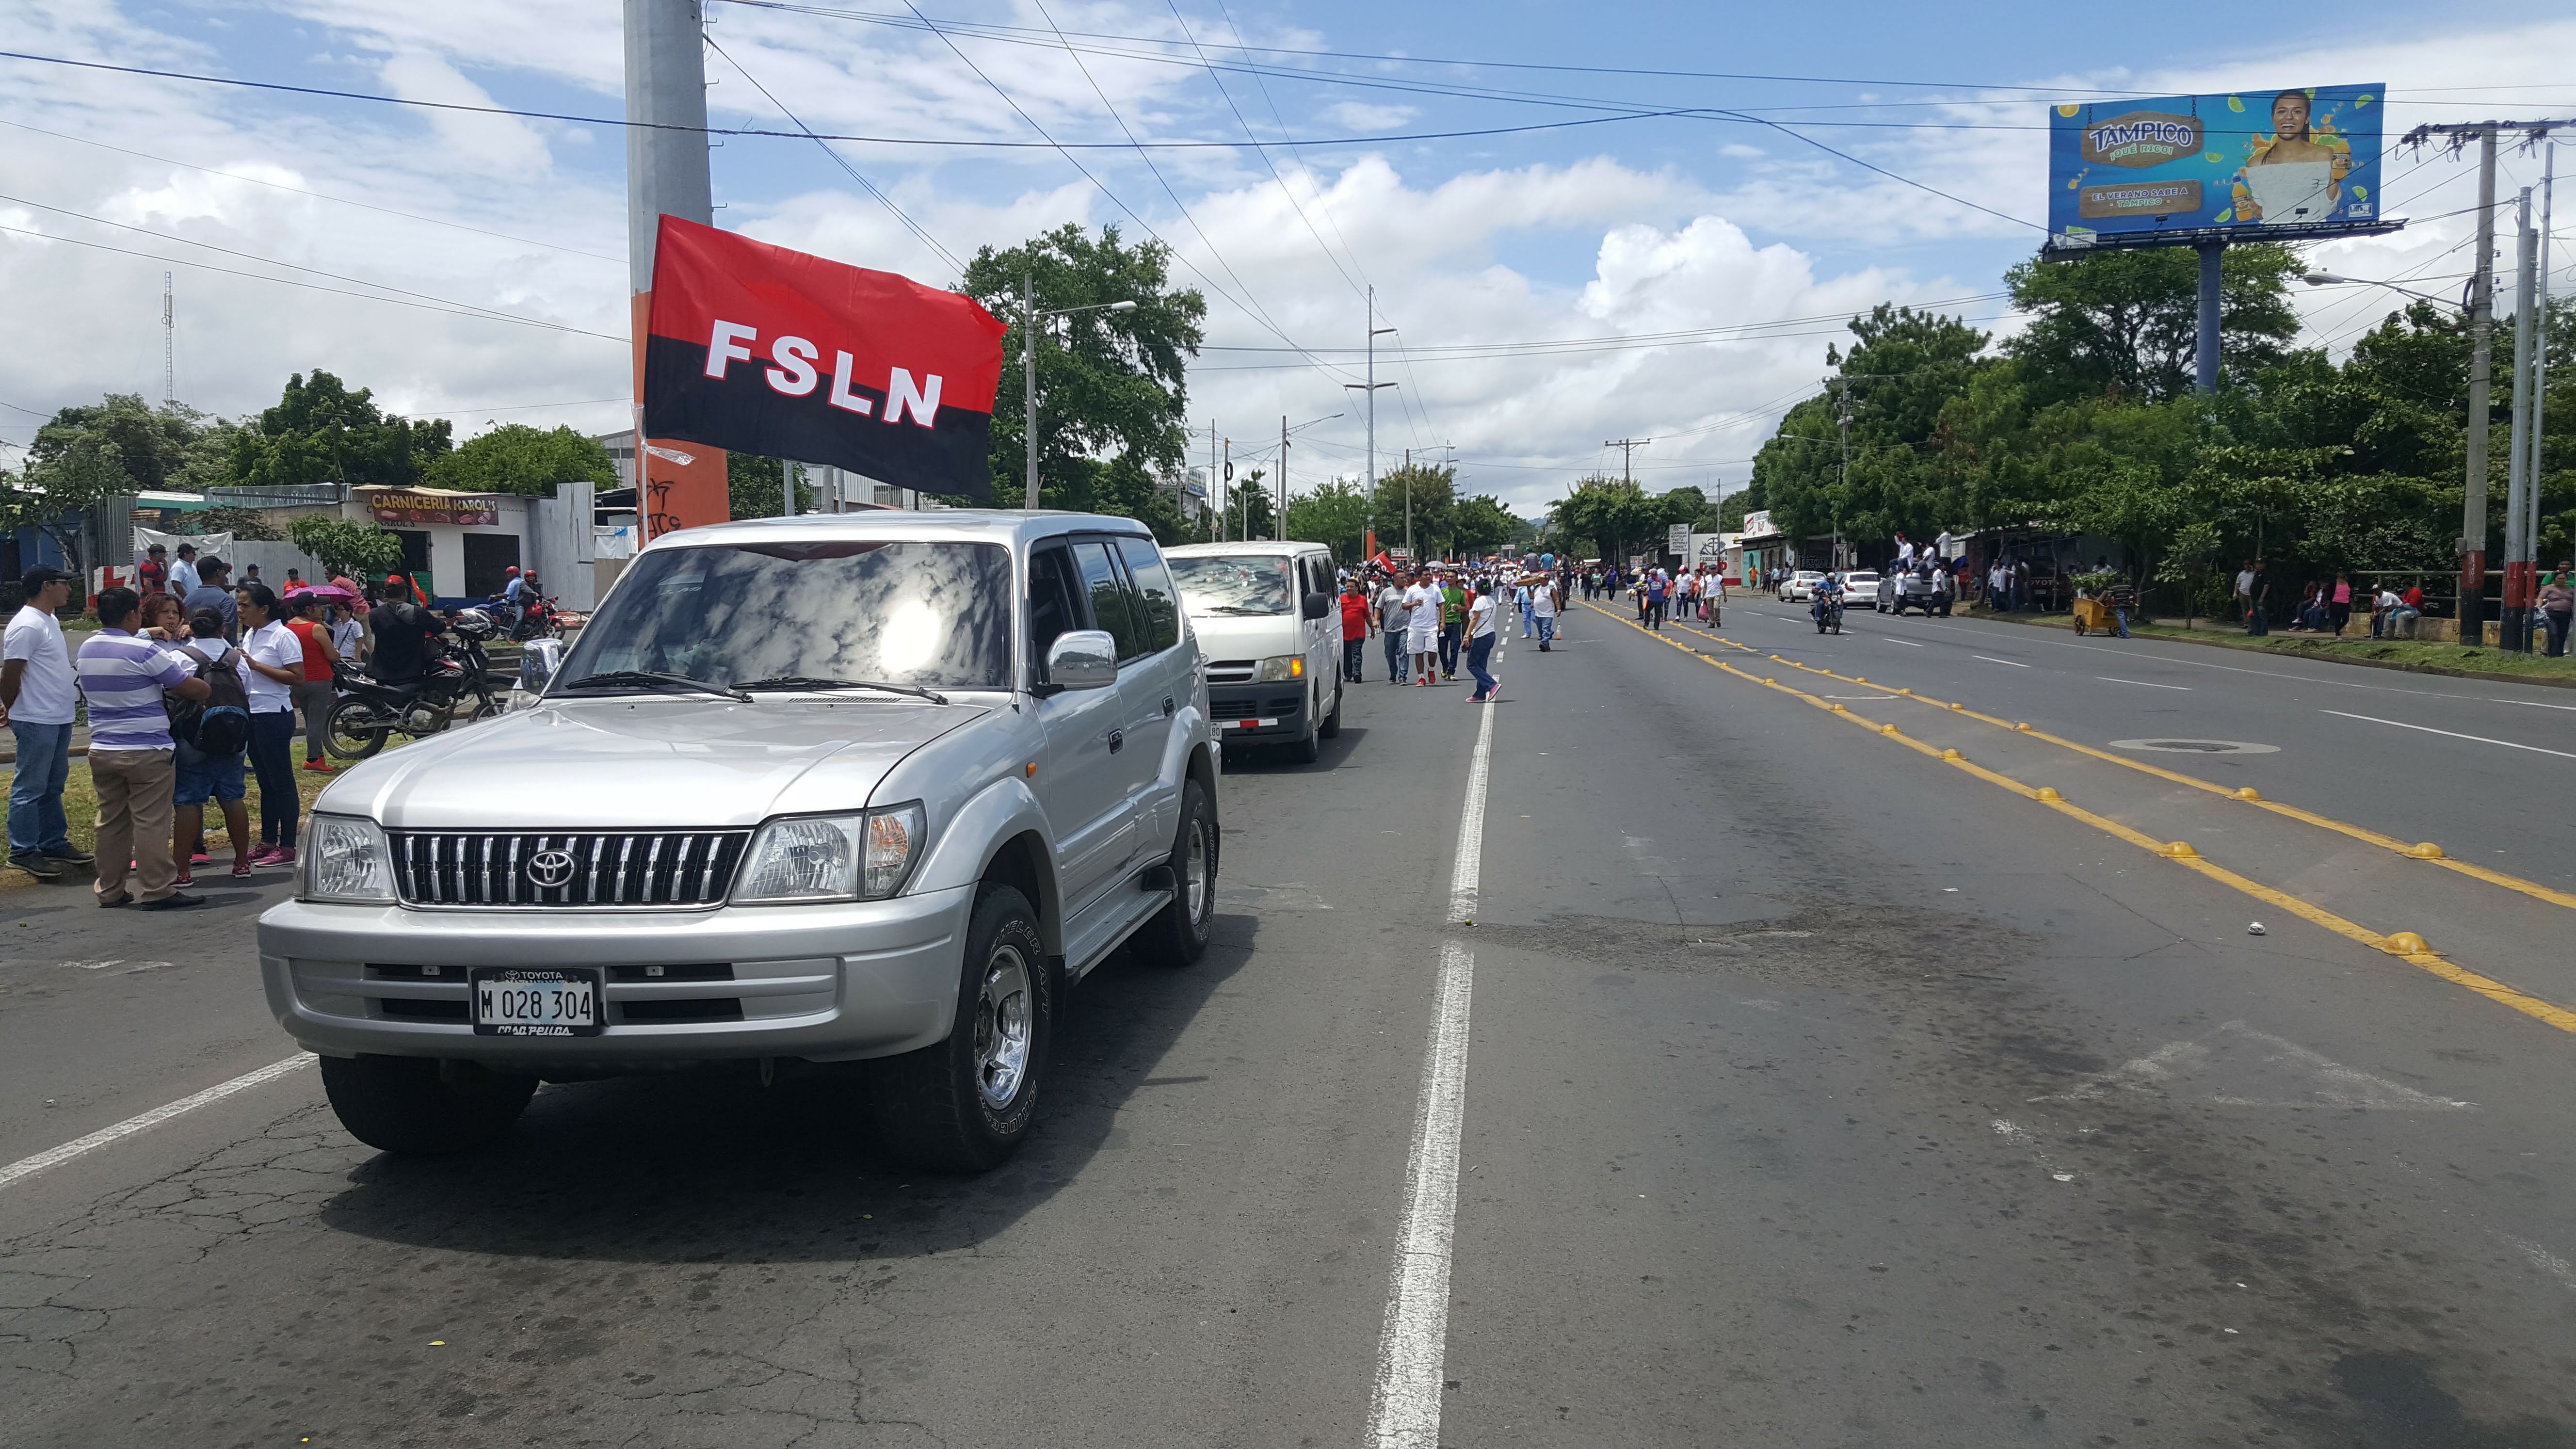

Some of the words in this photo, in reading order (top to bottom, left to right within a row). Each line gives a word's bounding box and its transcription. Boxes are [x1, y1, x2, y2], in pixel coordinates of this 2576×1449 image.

[2089, 121, 2193, 153] TAMPICO
[2092, 193, 2105, 201] EL
[2107, 190, 2150, 200] VERANO
[2151, 187, 2178, 197] SABE
[2116, 198, 2163, 208] TAMPICO
[704, 319, 943, 429] FSLN
[372, 494, 451, 510] CARNICERIA
[453, 499, 496, 512] KAROL'S
[520, 971, 564, 980] TOYOTA
[481, 990, 493, 1018] M
[502, 990, 542, 1019] 028
[551, 991, 591, 1020] 304
